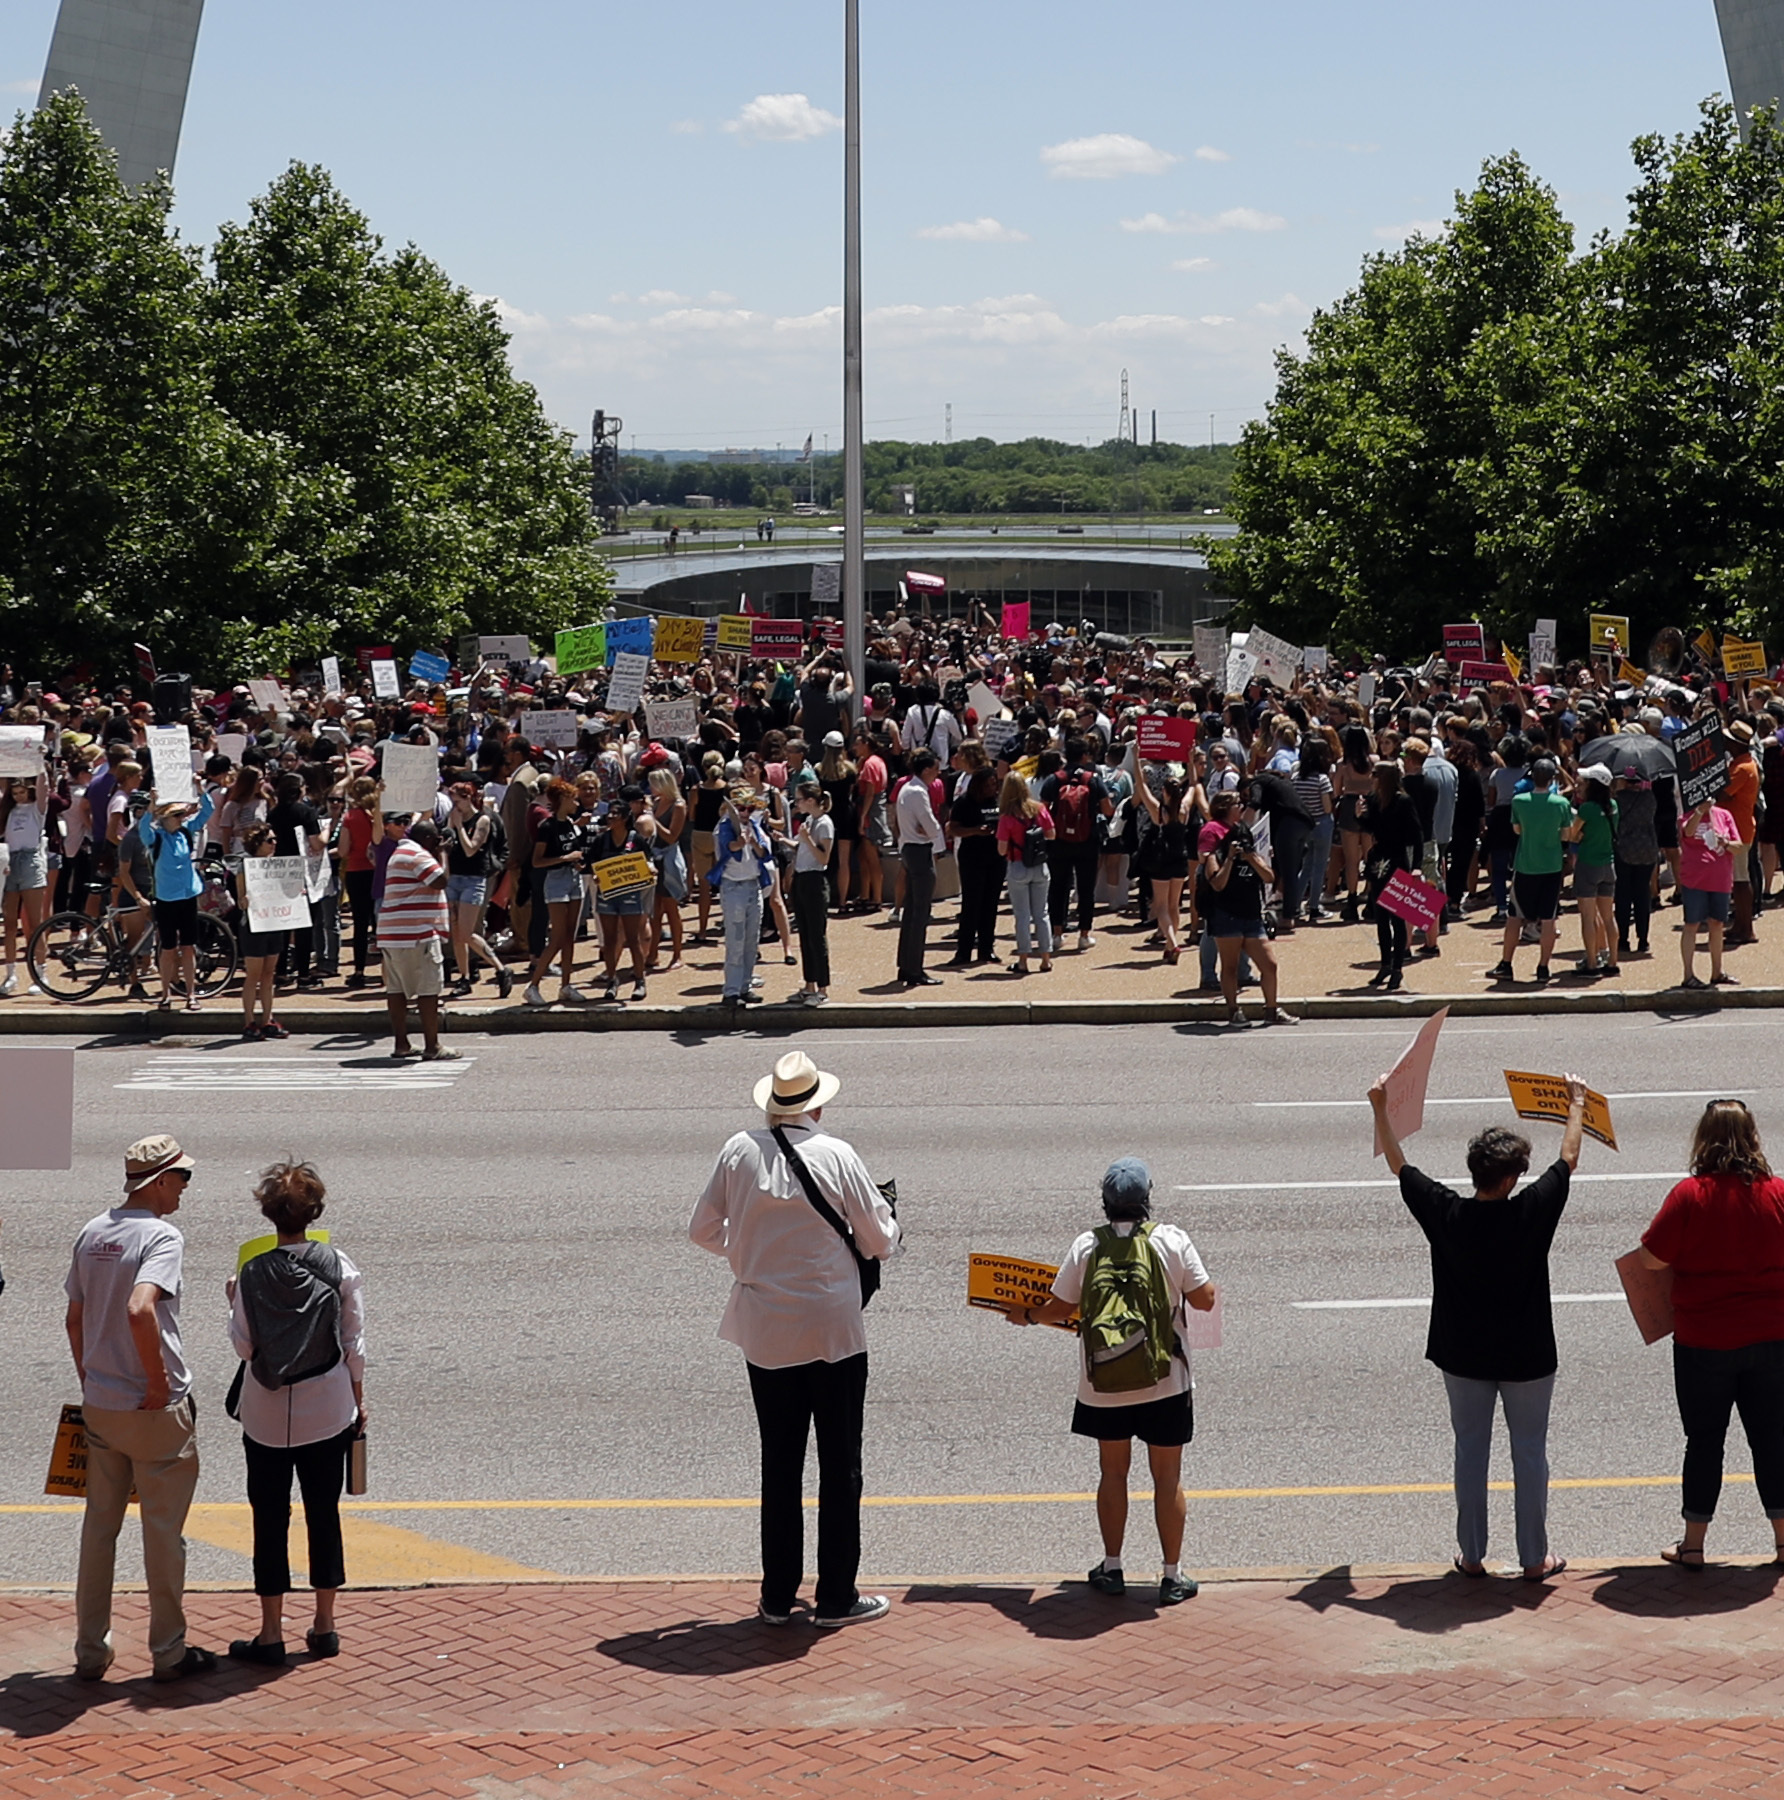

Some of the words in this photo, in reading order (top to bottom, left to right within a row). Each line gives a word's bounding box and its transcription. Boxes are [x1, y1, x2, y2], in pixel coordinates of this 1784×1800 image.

[728, 627, 750, 635] SHAM
[754, 635, 774, 643] SAFE,
[775, 635, 800, 643] LEGAL
[1729, 653, 1753, 662] SHAME
[653, 710, 667, 721] WE
[1674, 730, 1702, 753] Women
[1702, 715, 1719, 737] will
[1688, 738, 1716, 772] DIE
[1681, 759, 1726, 795] Republicans
[1688, 784, 1709, 806] don't
[596, 859, 622, 871] Governor
[607, 865, 636, 877] SHAME
[624, 873, 640, 882] YOU
[1389, 877, 1409, 892] Don't
[1409, 888, 1427, 902] Take
[1384, 886, 1404, 901] Away
[1404, 897, 1419, 908] Our
[1418, 905, 1435, 920] Care.
[1509, 1074, 1566, 1087] Governo
[1537, 1100, 1559, 1110] on
[973, 1257, 1036, 1275] Governor
[993, 1287, 1016, 1299] on
[48, 1475, 80, 1489] Parson
